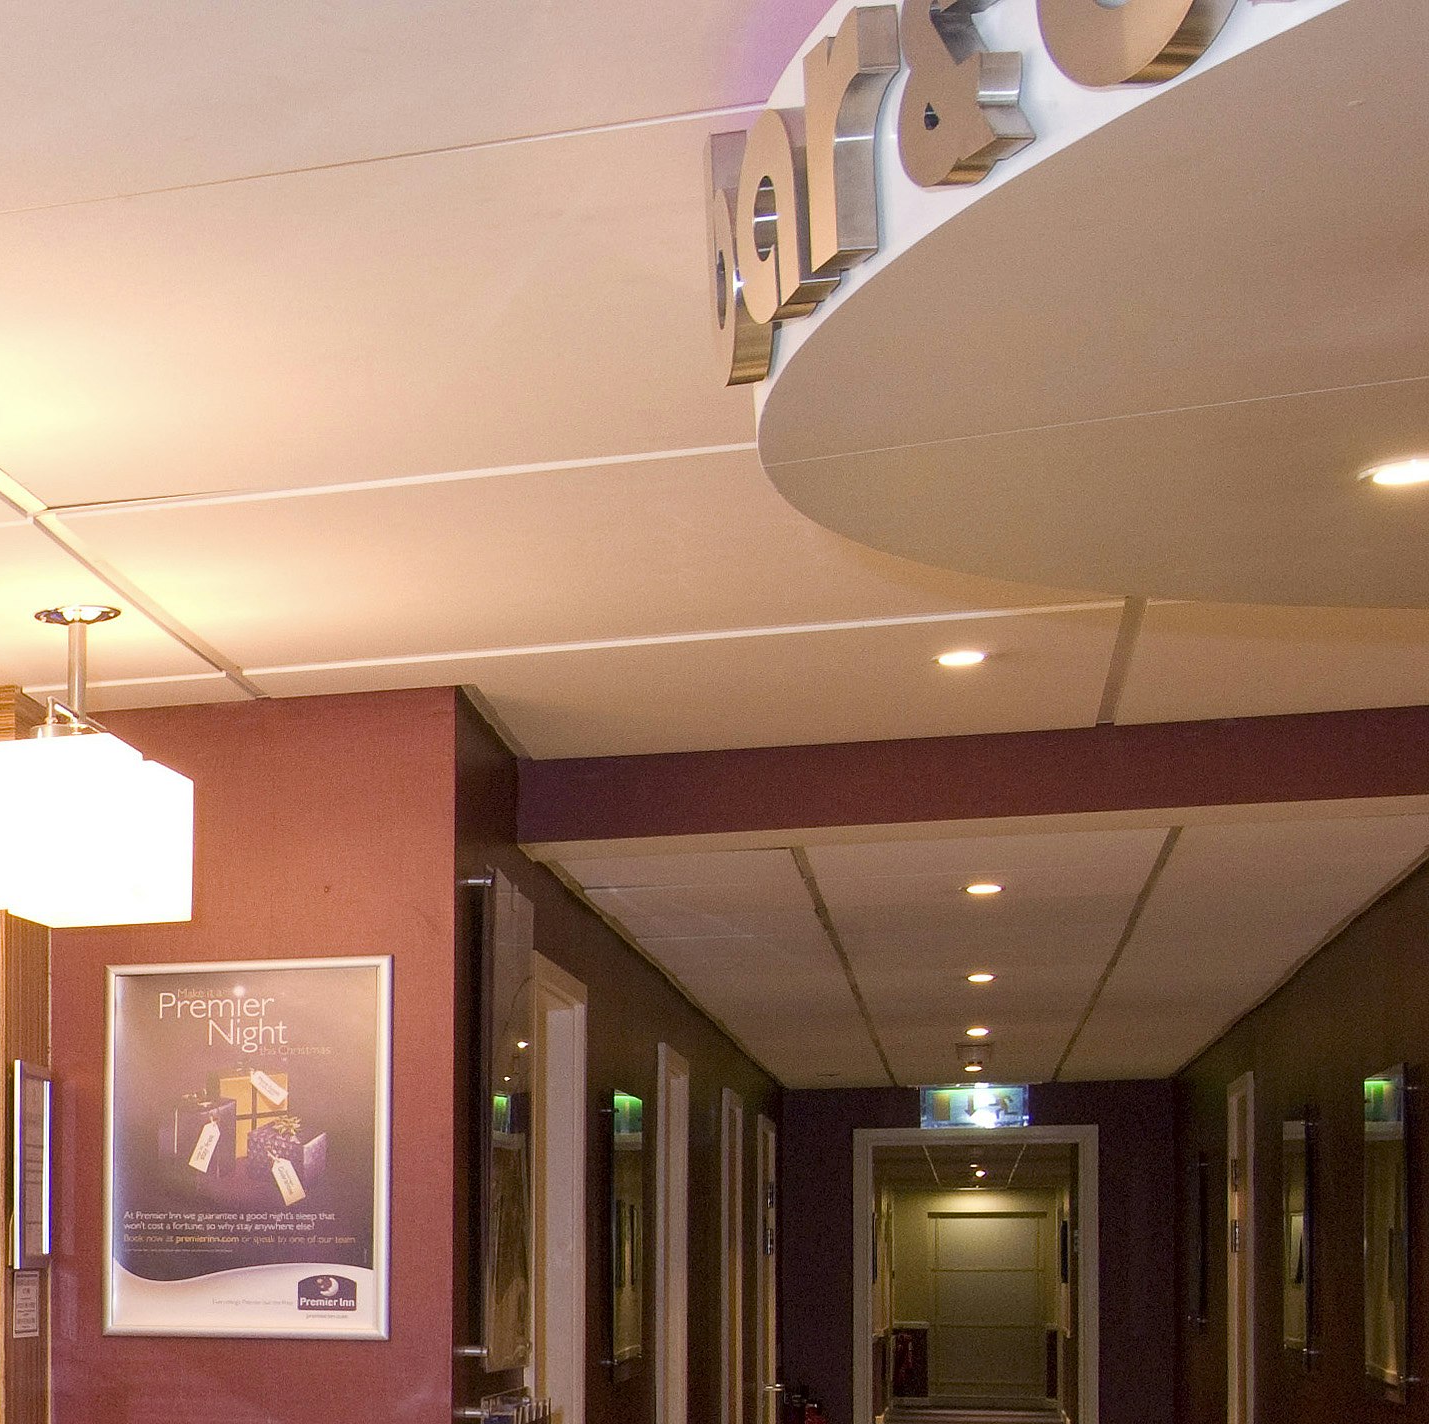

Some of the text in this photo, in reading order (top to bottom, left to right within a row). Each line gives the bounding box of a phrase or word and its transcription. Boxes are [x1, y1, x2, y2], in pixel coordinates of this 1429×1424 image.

[159, 991, 275, 1018] Premier
[208, 1019, 288, 1053] Night
[123, 1211, 134, 1220] At
[136, 1211, 168, 1220] Premier
[169, 1211, 182, 1220] Inn
[197, 1213, 238, 1222] guarantee
[246, 1212, 267, 1222] good
[269, 1211, 294, 1222] night's
[295, 1212, 317, 1222] sleep
[319, 1212, 336, 1221] that
[123, 1221, 145, 1230] won't
[147, 1222, 164, 1230] cost
[217, 1222, 234, 1232] why
[236, 1223, 253, 1232] stay
[254, 1222, 294, 1232] anywhere
[175, 1235, 240, 1245] premierinn.com
[335, 1236, 356, 1244] team
[299, 1297, 355, 1307] Premier Inn
